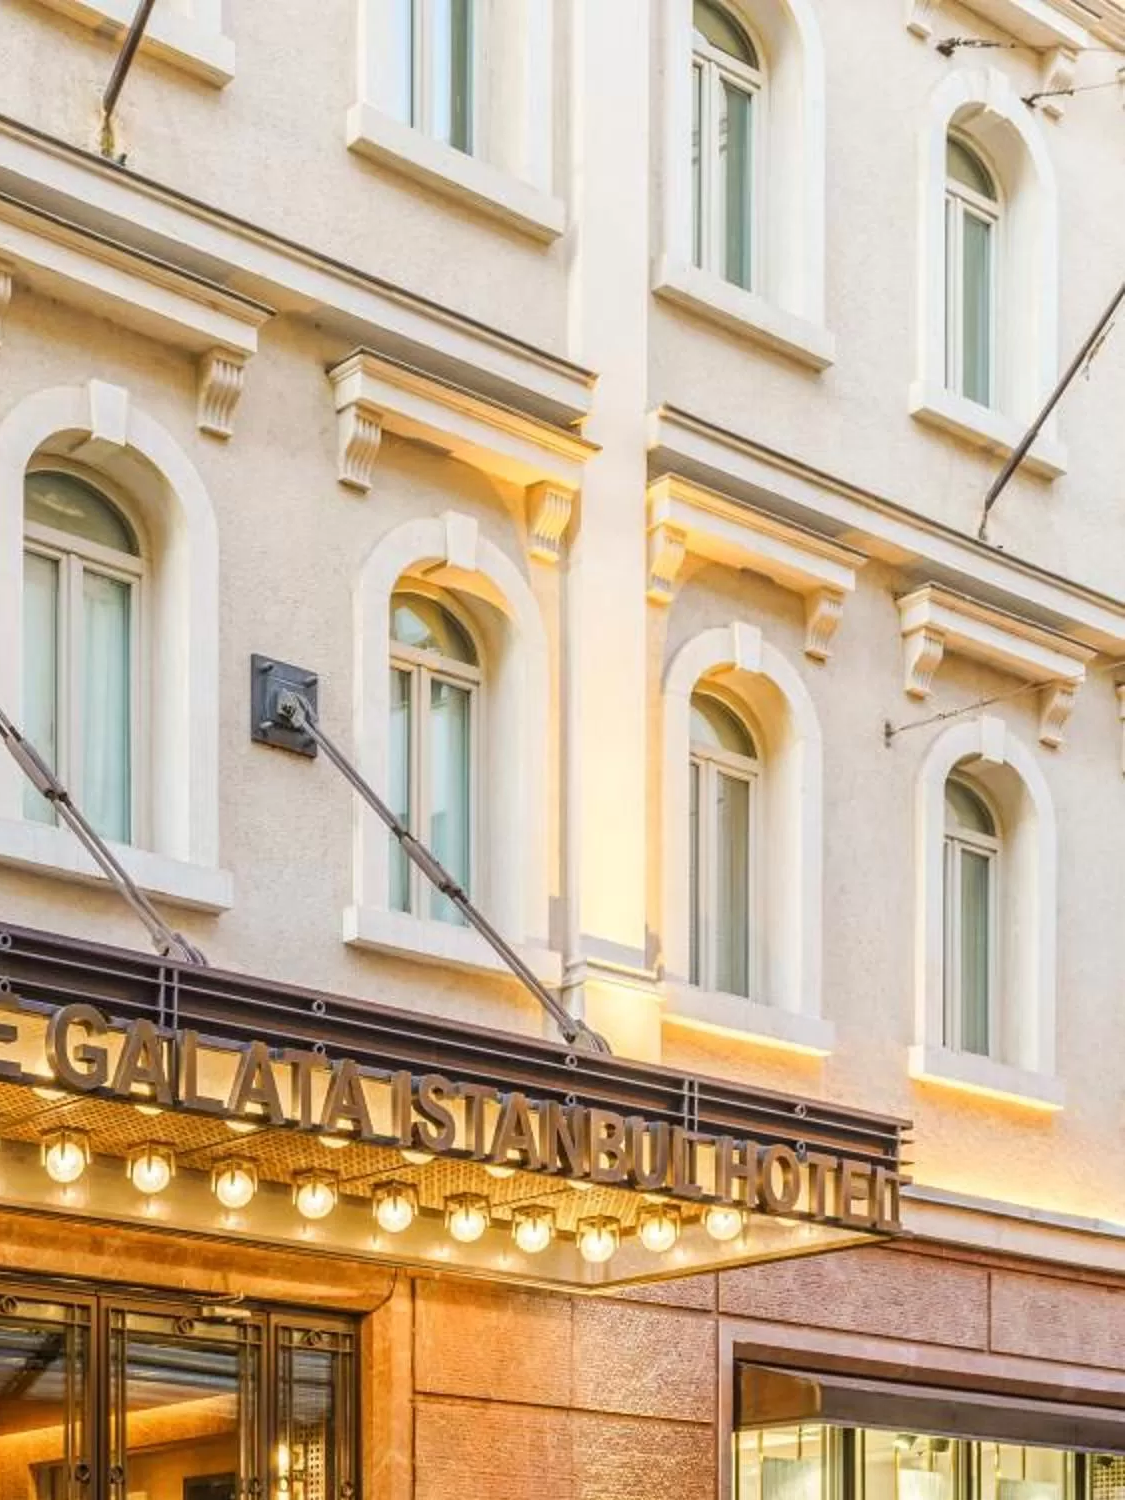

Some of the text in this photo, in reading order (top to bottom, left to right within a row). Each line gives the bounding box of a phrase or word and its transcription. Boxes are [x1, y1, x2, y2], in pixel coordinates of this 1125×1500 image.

[46, 1003, 373, 1139] GALATA
[391, 1070, 703, 1198] ISTANBUL
[715, 1134, 903, 1230] HOTEL
